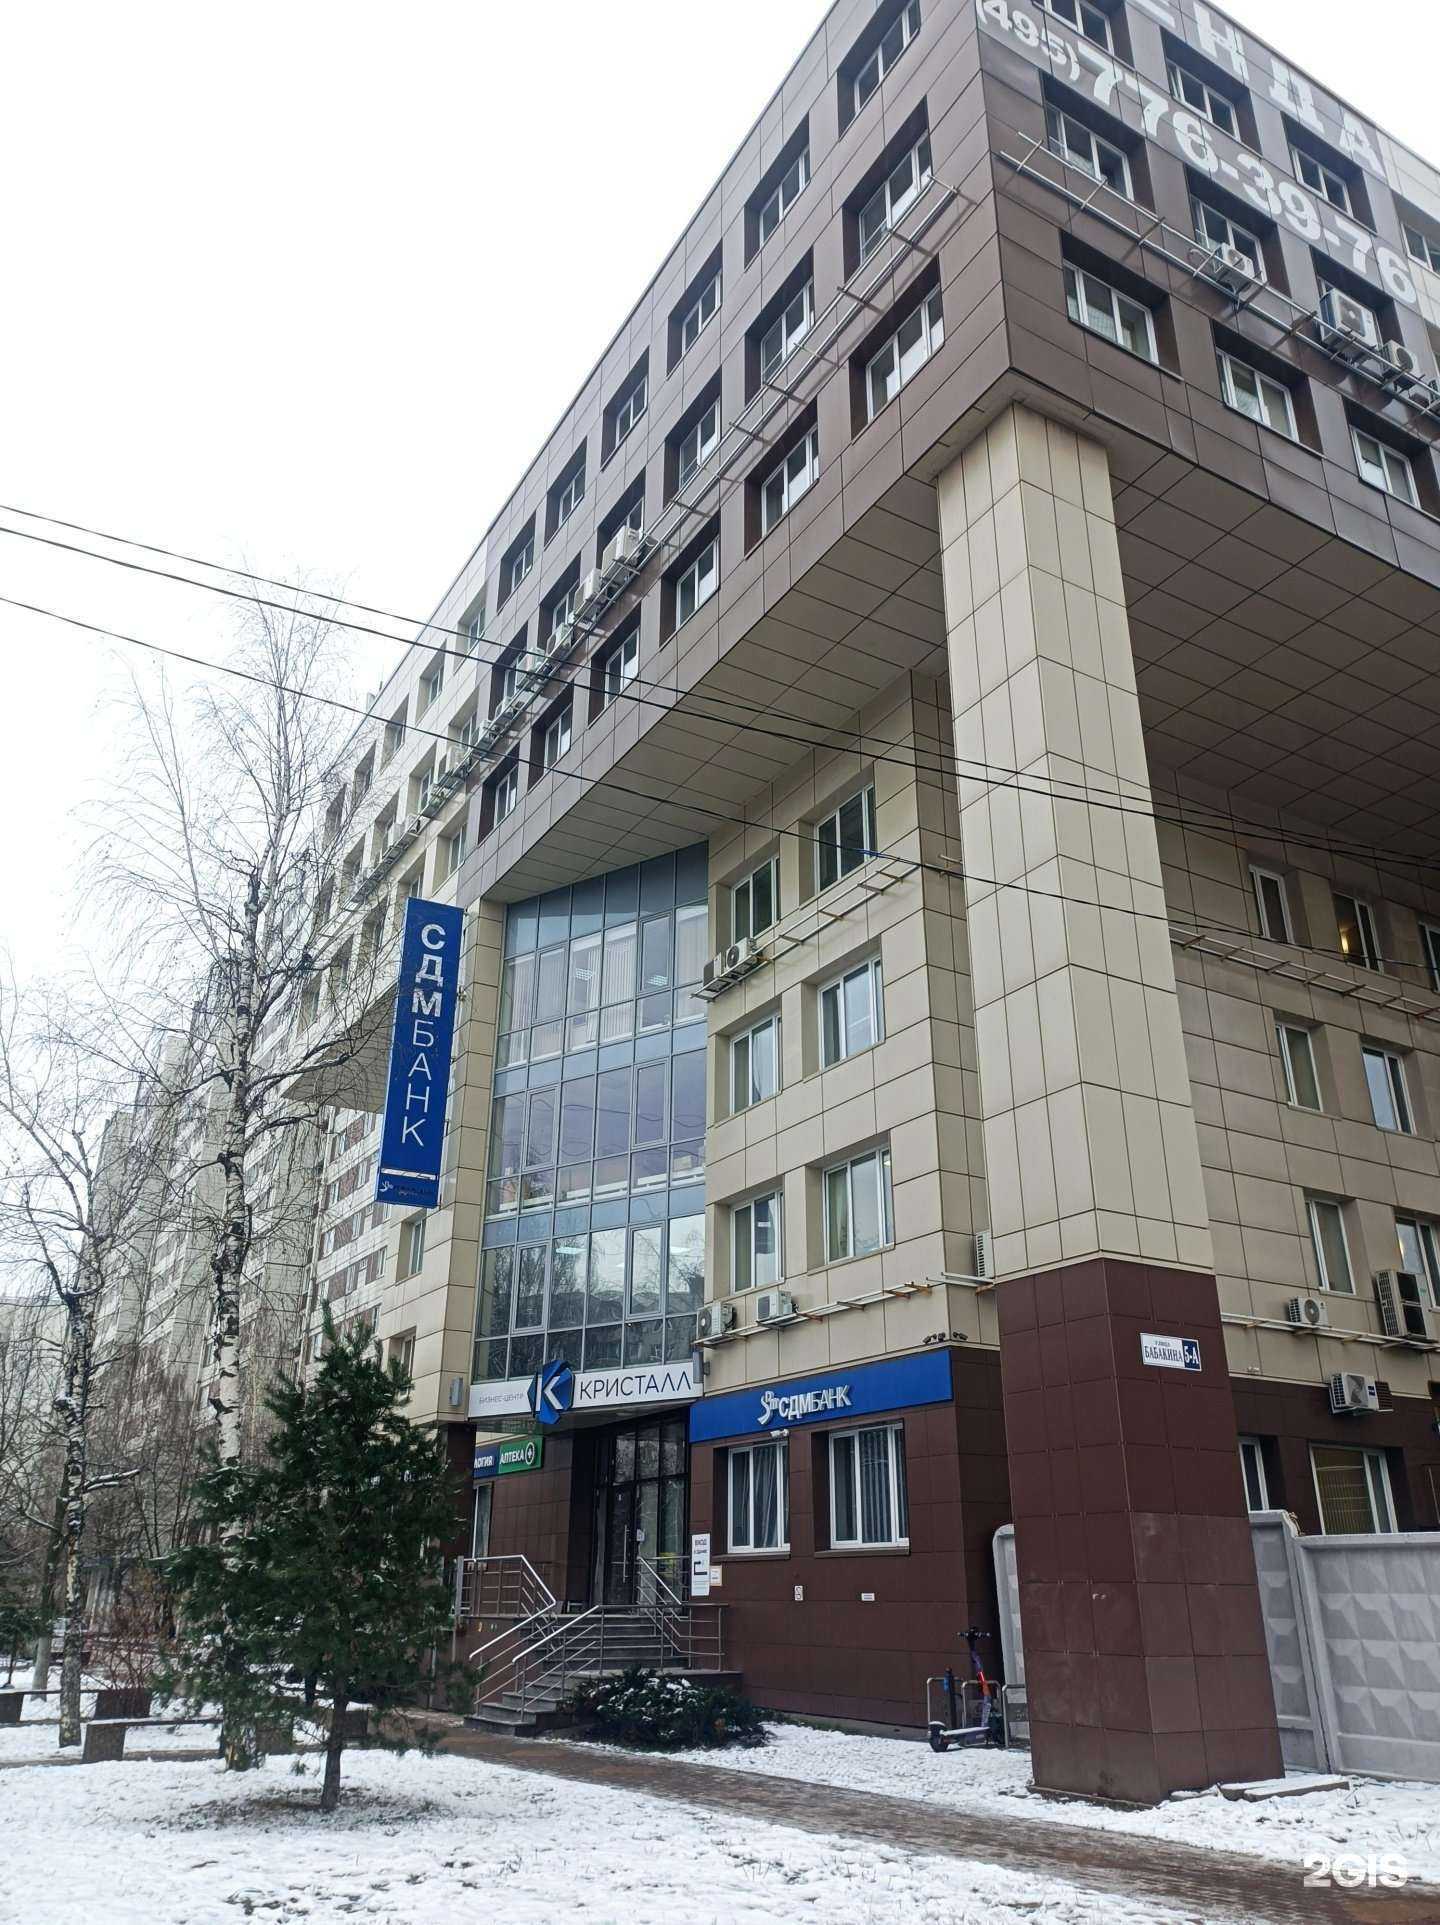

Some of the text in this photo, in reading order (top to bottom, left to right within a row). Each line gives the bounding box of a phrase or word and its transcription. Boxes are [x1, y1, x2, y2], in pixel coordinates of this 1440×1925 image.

[401, 923, 447, 1147] СДМБАНК
[1144, 1346, 1184, 1362] БАБАКИНА
[580, 1371, 691, 1400] КРИСТАЛЛ
[500, 1449, 525, 1464] АПТЕКА
